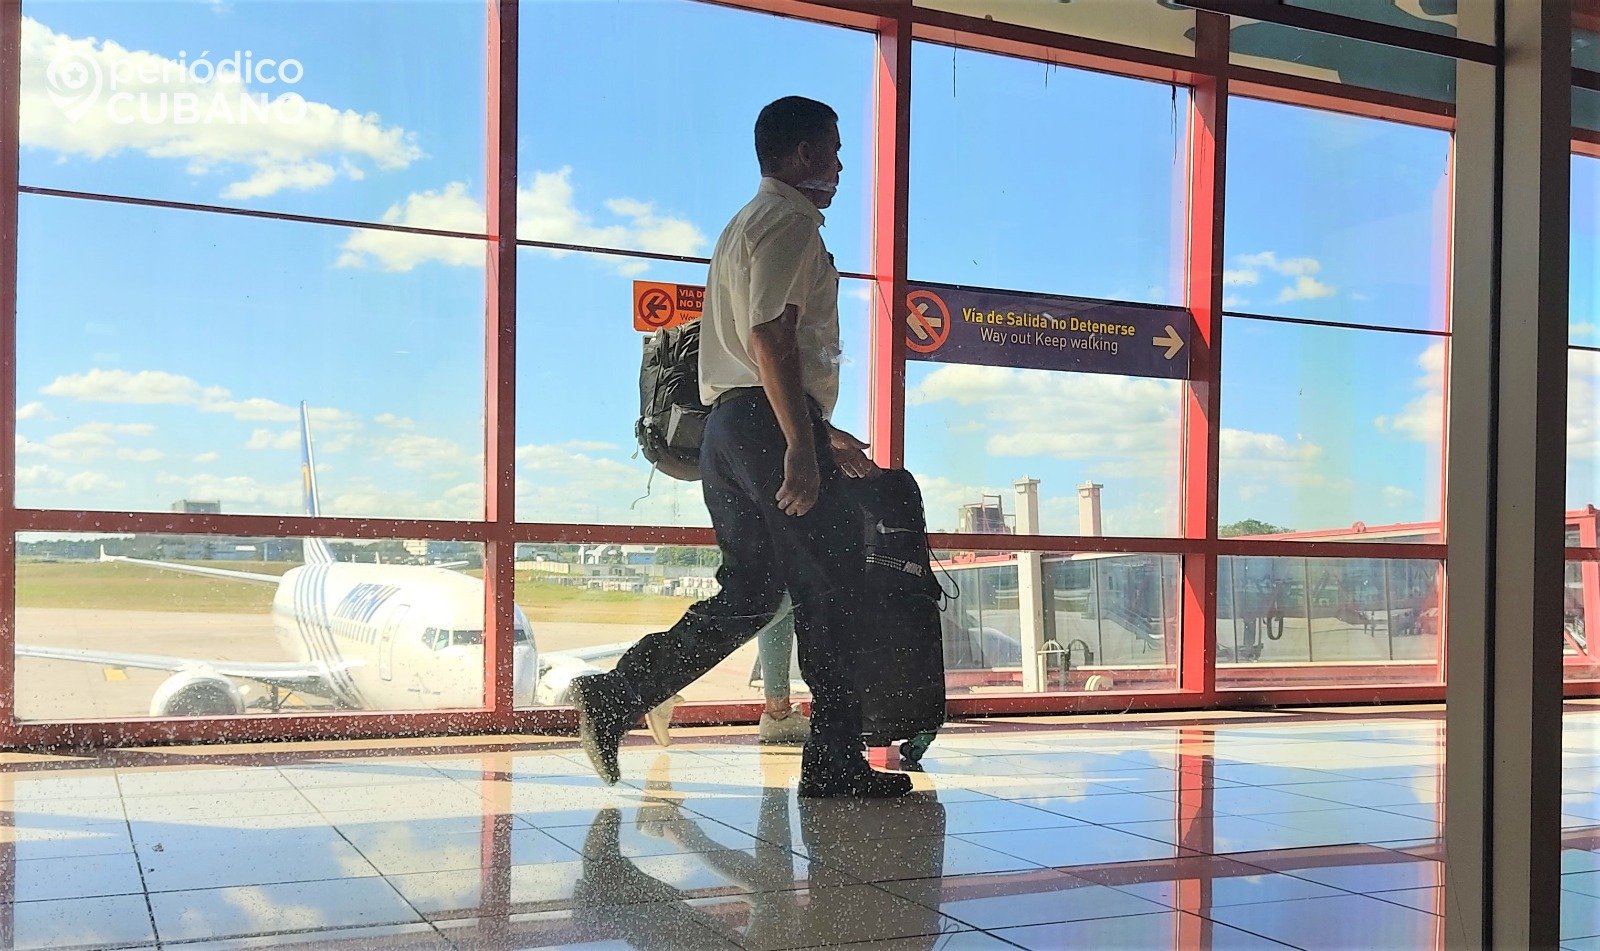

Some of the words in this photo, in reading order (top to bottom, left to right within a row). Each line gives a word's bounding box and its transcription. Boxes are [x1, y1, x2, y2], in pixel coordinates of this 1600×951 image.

[680, 290, 695, 298] VIA
[680, 300, 694, 308] NO
[962, 307, 984, 323] Vía
[987, 310, 1004, 325] de
[1006, 312, 1048, 329] Salida
[1051, 318, 1067, 330] no
[1070, 317, 1136, 336] Detenerse
[980, 327, 1007, 346] Way
[1010, 332, 1032, 345] out
[1035, 331, 1067, 351] Keep
[1070, 335, 1118, 355] walking
